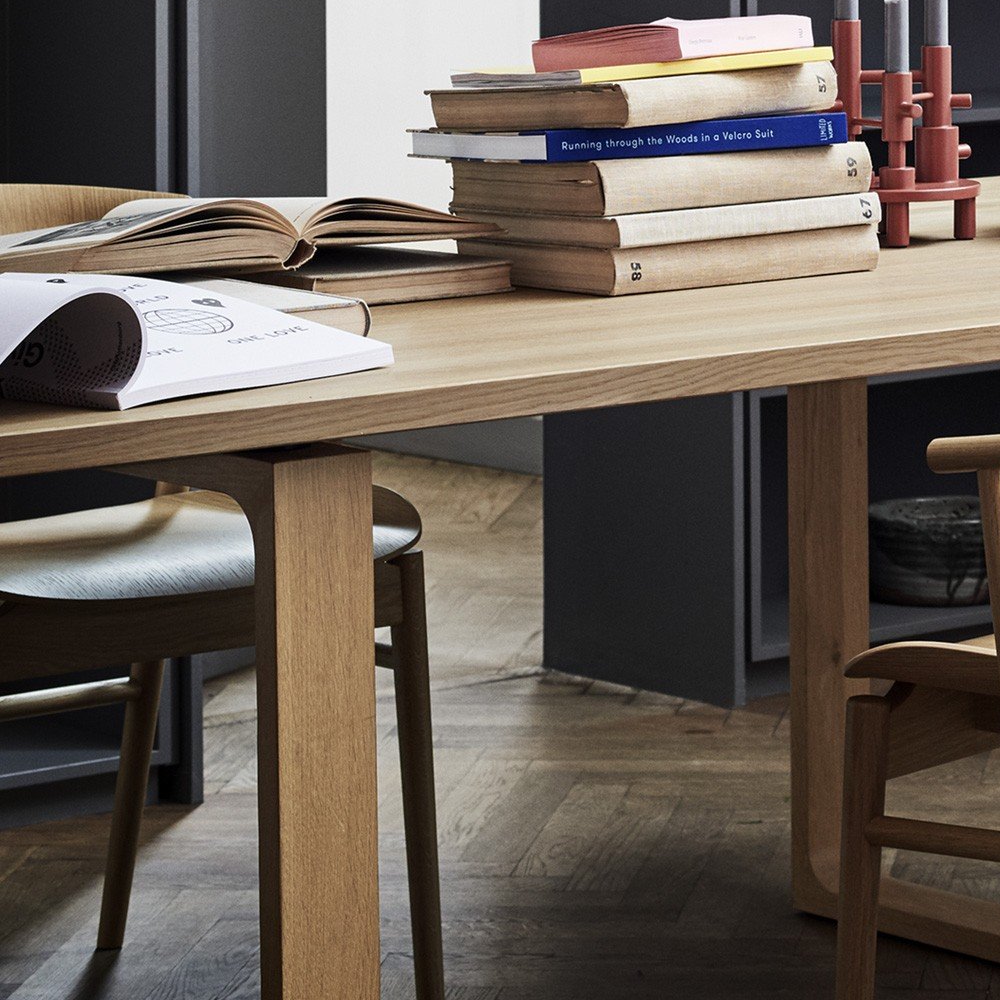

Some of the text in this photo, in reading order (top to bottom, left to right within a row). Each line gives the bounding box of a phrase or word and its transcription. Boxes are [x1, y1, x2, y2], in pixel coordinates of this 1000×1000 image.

[816, 75, 827, 93] 57
[818, 118, 828, 141] LIMITED
[826, 120, 834, 139] WORKS
[561, 128, 774, 151] Running through the Woods in a Velcro Suit
[846, 157, 858, 177] 59
[860, 198, 872, 219] 67
[630, 262, 642, 281] 58
[227, 325, 309, 343] ONE LOVE
